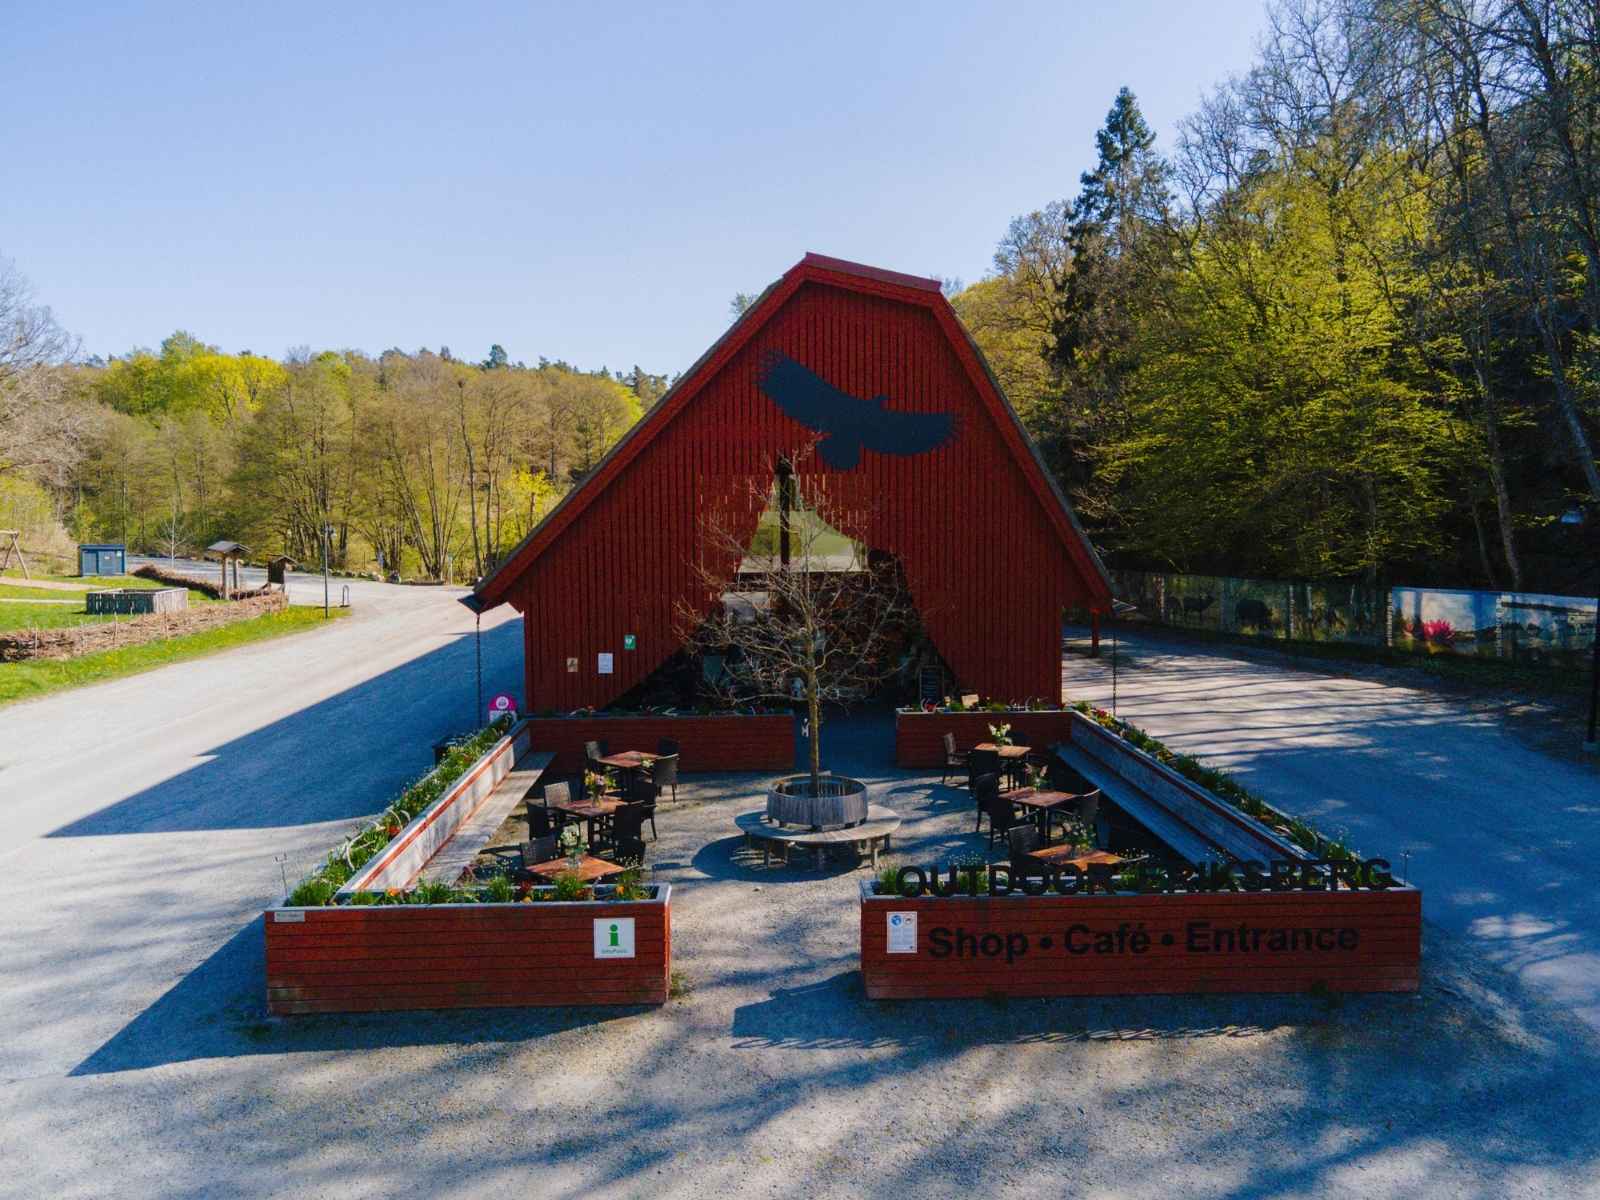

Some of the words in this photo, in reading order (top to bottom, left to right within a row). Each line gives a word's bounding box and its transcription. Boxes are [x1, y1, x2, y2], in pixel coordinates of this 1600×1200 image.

[896, 864, 1117, 898] OUTDOOR
[1138, 858, 1392, 895] ERIKSBERG
[928, 926, 1029, 964] Shop
[1065, 921, 1151, 955] Café
[1185, 921, 1359, 953] Entrance
